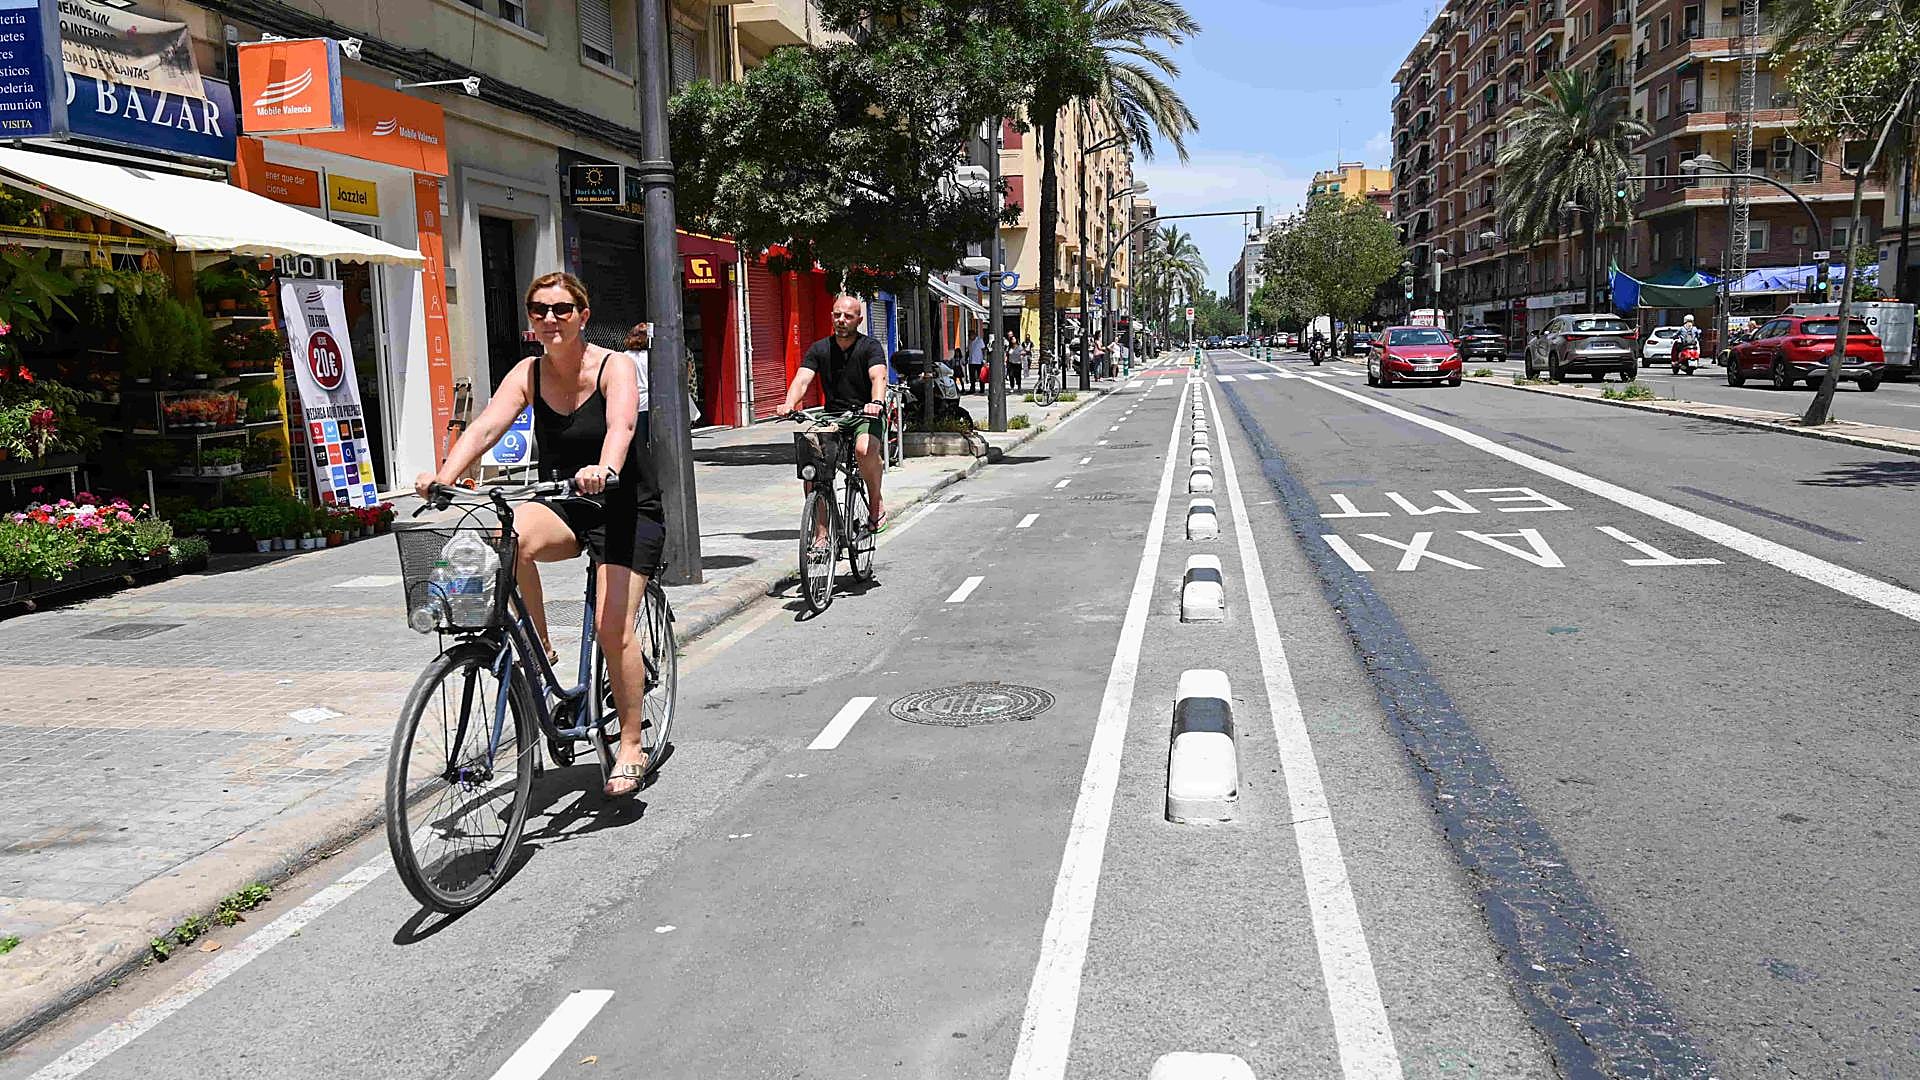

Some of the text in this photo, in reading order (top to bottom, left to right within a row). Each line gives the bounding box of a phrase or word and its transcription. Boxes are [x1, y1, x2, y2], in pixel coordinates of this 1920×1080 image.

[93, 12, 110, 26] UN
[96, 79, 224, 138] BAZAR
[257, 104, 312, 116] Mobile Valencia
[2, 119, 32, 129] VISITA
[399, 126, 438, 145] Mobile Valencia
[281, 174, 294, 184] que
[337, 187, 368, 206] Jazztel
[313, 347, 339, 378] 20€
[1320, 525, 1726, 572] TAXI
